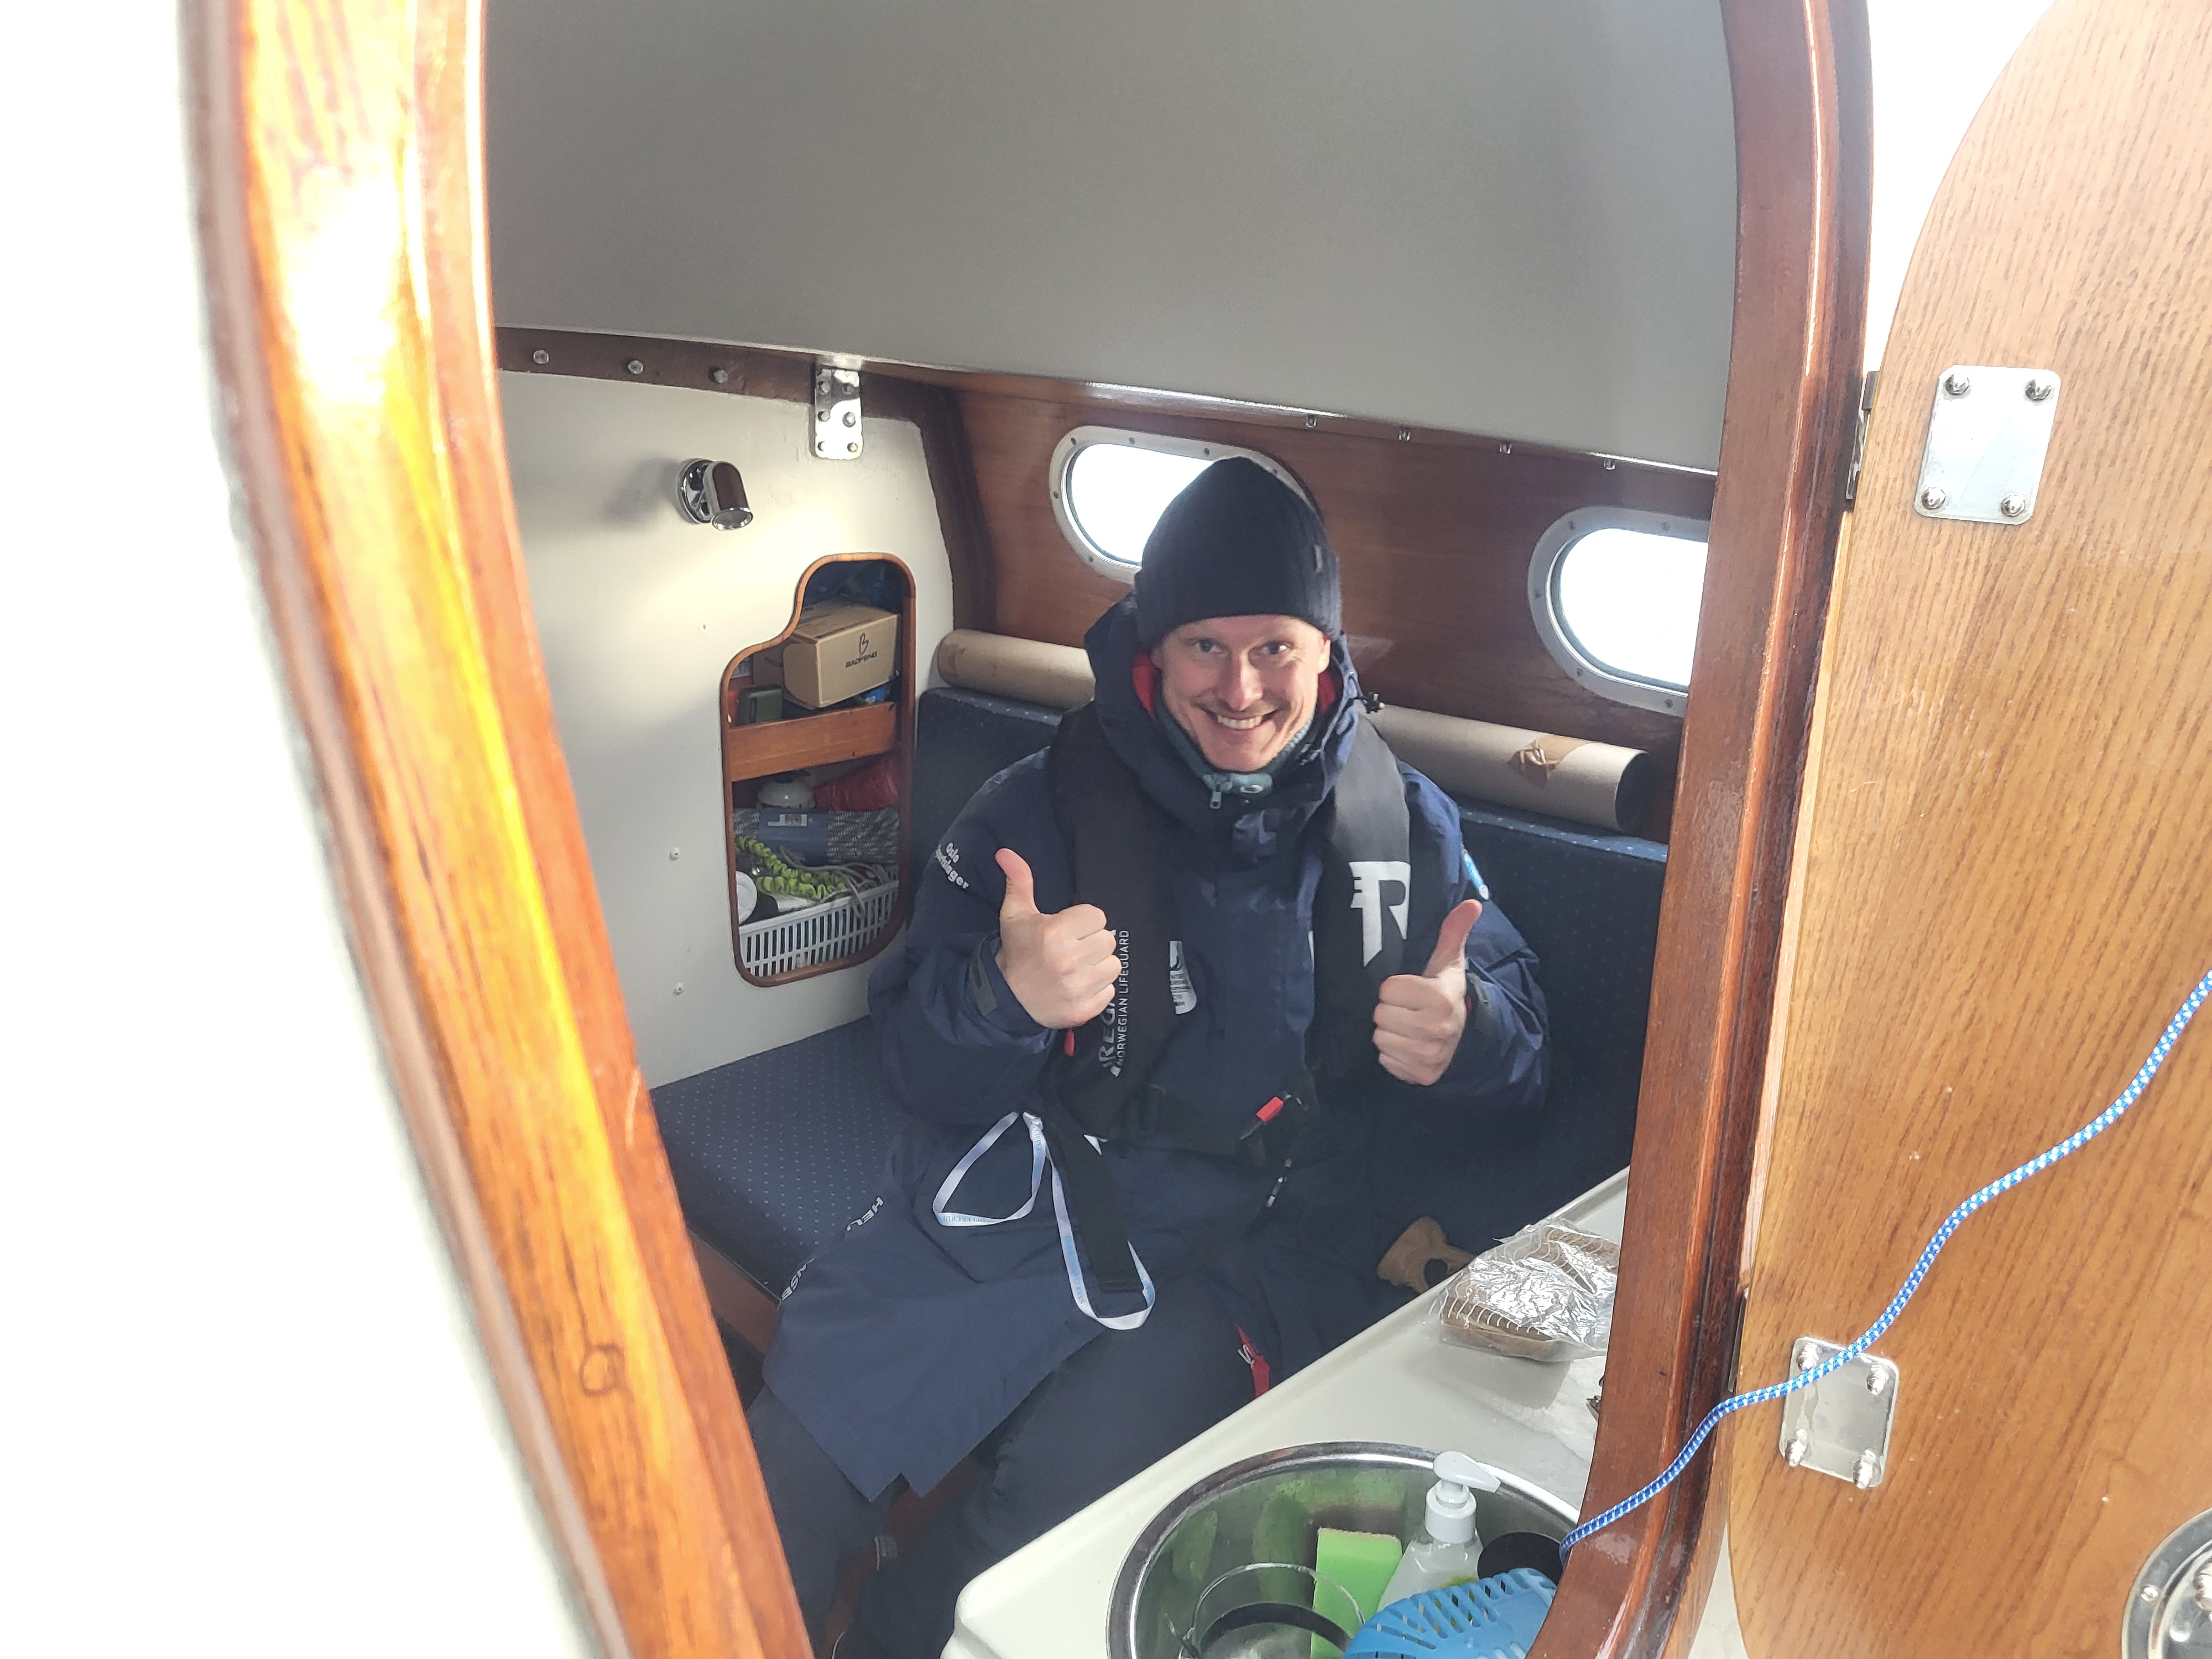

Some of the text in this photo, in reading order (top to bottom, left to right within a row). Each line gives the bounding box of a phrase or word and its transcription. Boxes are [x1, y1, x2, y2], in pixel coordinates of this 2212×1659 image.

[845, 651, 878, 668] BAOFENG
[1116, 929, 1130, 1065] NORWEGIAN LIFEGUARD
